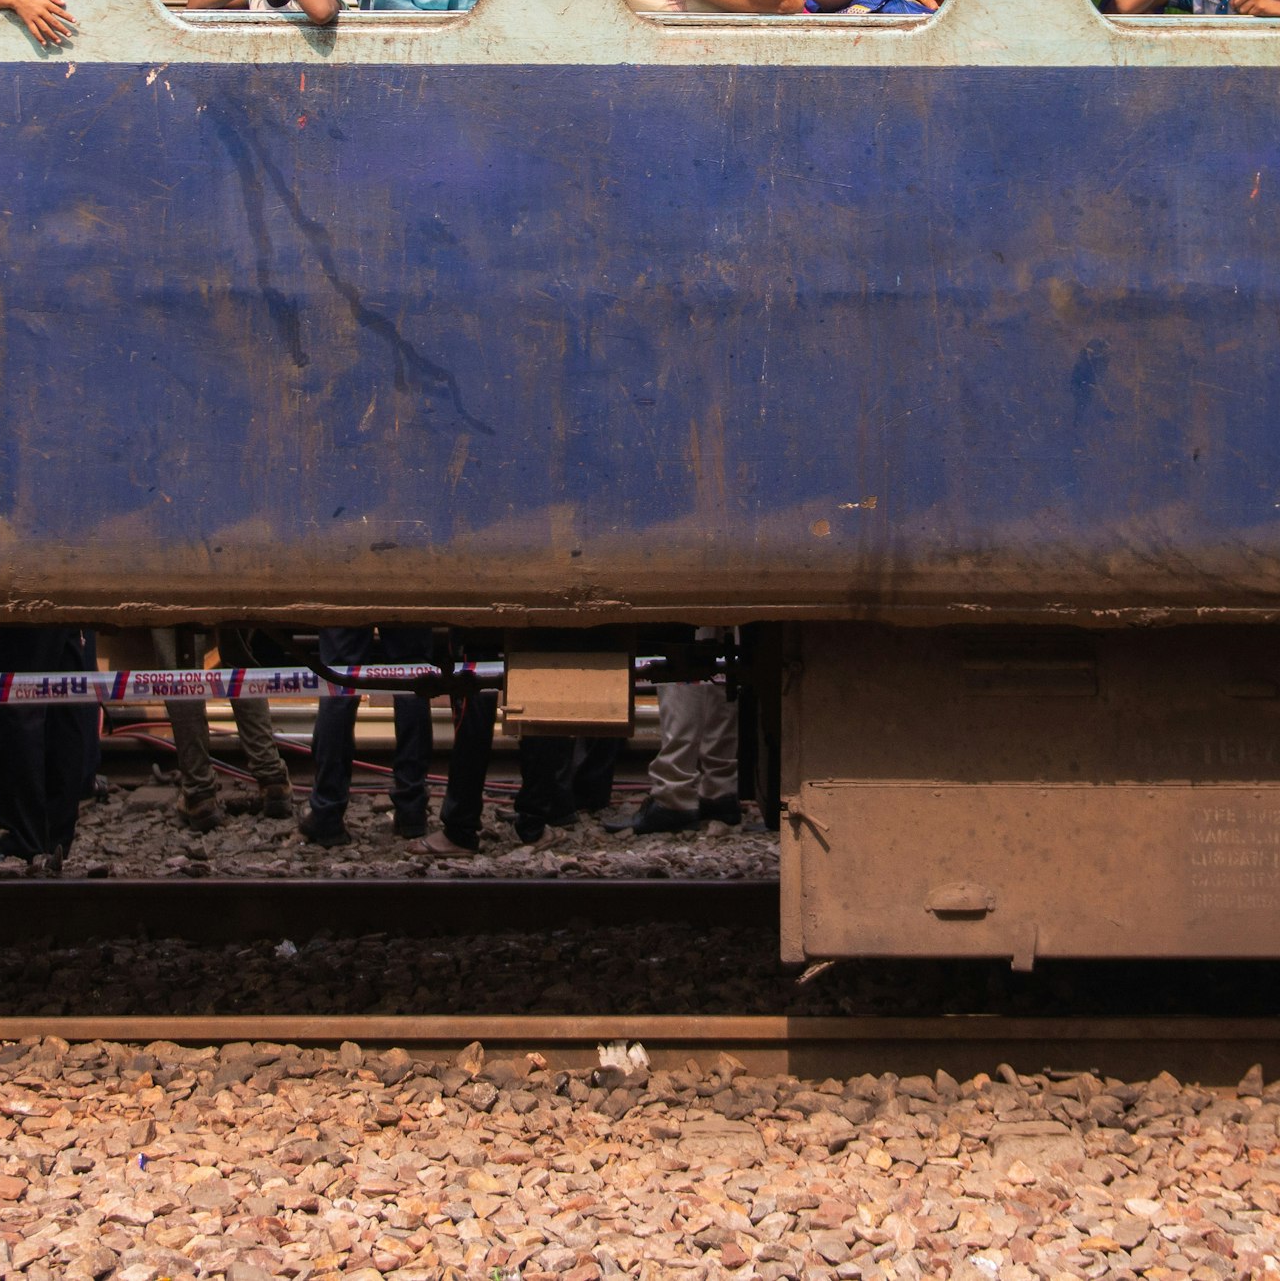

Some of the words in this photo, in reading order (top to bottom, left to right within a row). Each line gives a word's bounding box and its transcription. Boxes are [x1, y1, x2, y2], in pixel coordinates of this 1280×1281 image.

[179, 673, 201, 683] NOT
[205, 672, 220, 682] DO
[366, 667, 406, 678] CROSS
[135, 673, 174, 685] CROSS
[268, 672, 319, 690] RPF
[36, 676, 88, 695] RPF
[152, 684, 205, 696] CAUTION
